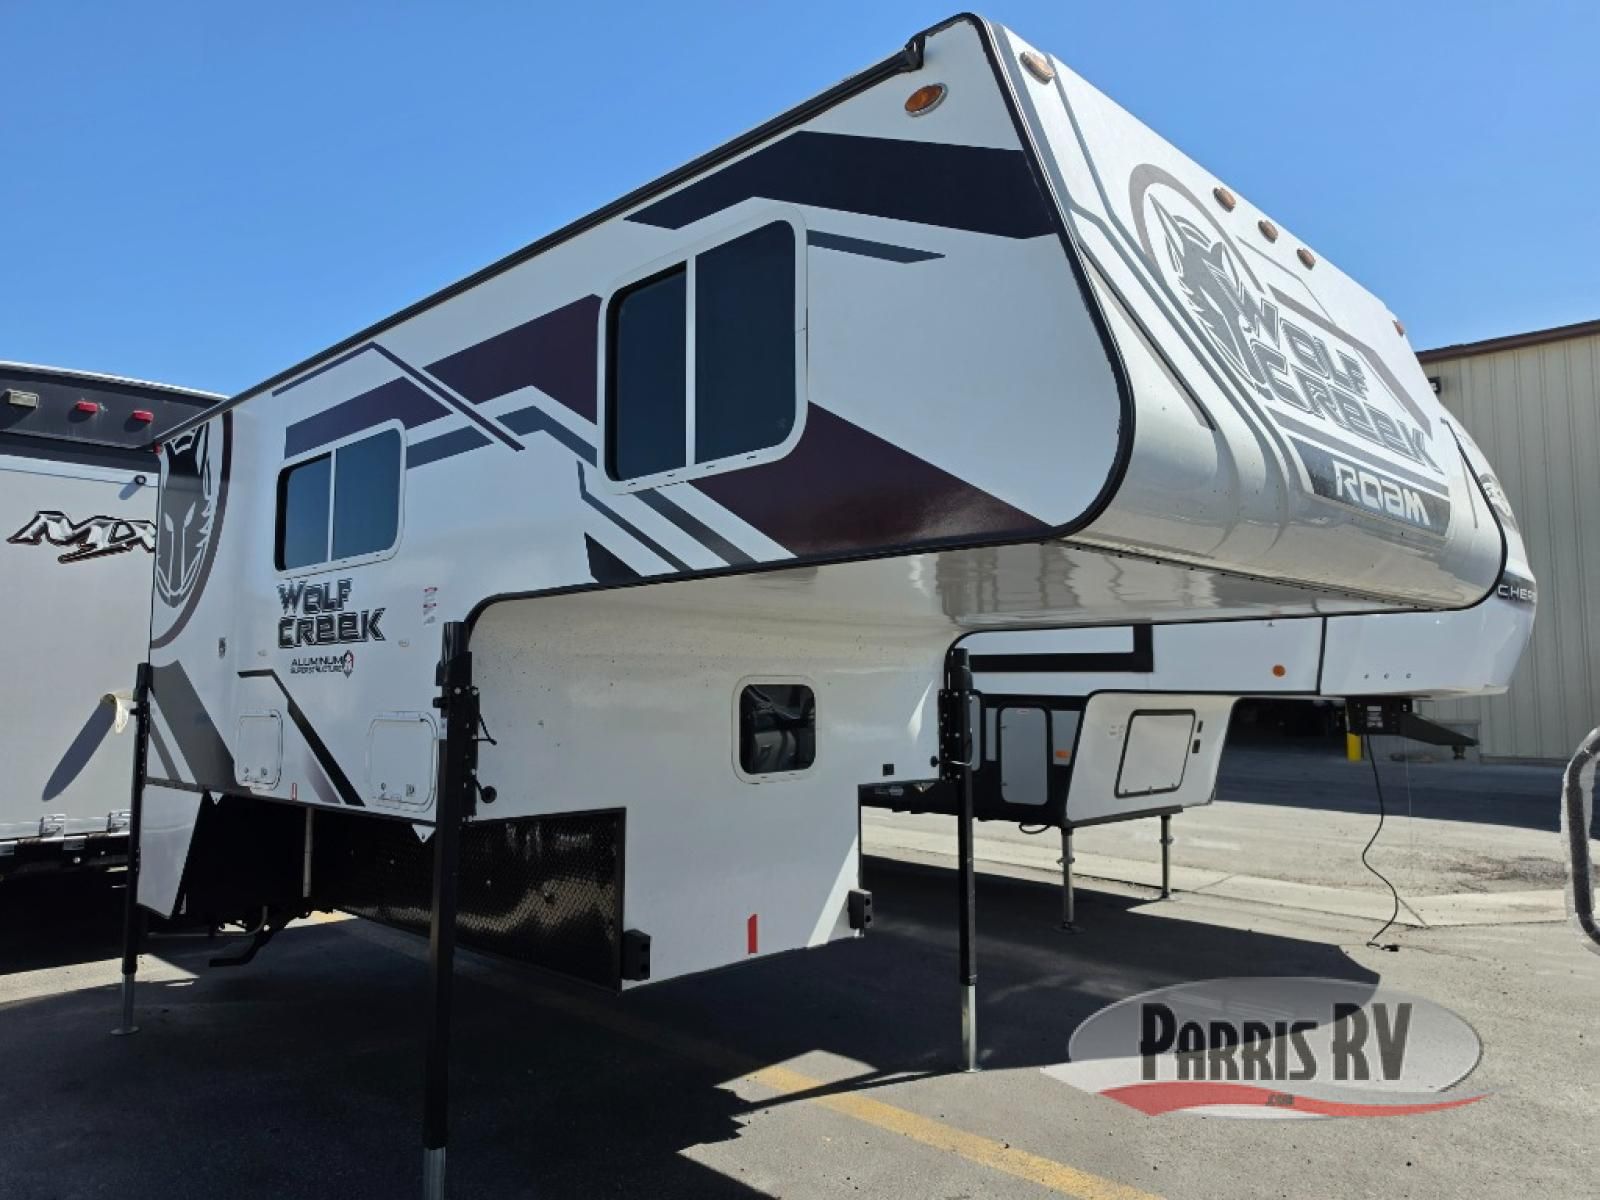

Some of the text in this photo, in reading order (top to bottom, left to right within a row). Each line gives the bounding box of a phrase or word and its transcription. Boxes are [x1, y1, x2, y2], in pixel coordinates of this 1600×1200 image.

[1237, 282, 1370, 400] WOLF
[1250, 337, 1445, 477] CREEK
[1332, 459, 1432, 527] ROAM
[277, 577, 352, 614] WOLF
[278, 607, 386, 649] CREEK
[291, 655, 344, 666] ALUMINUM
